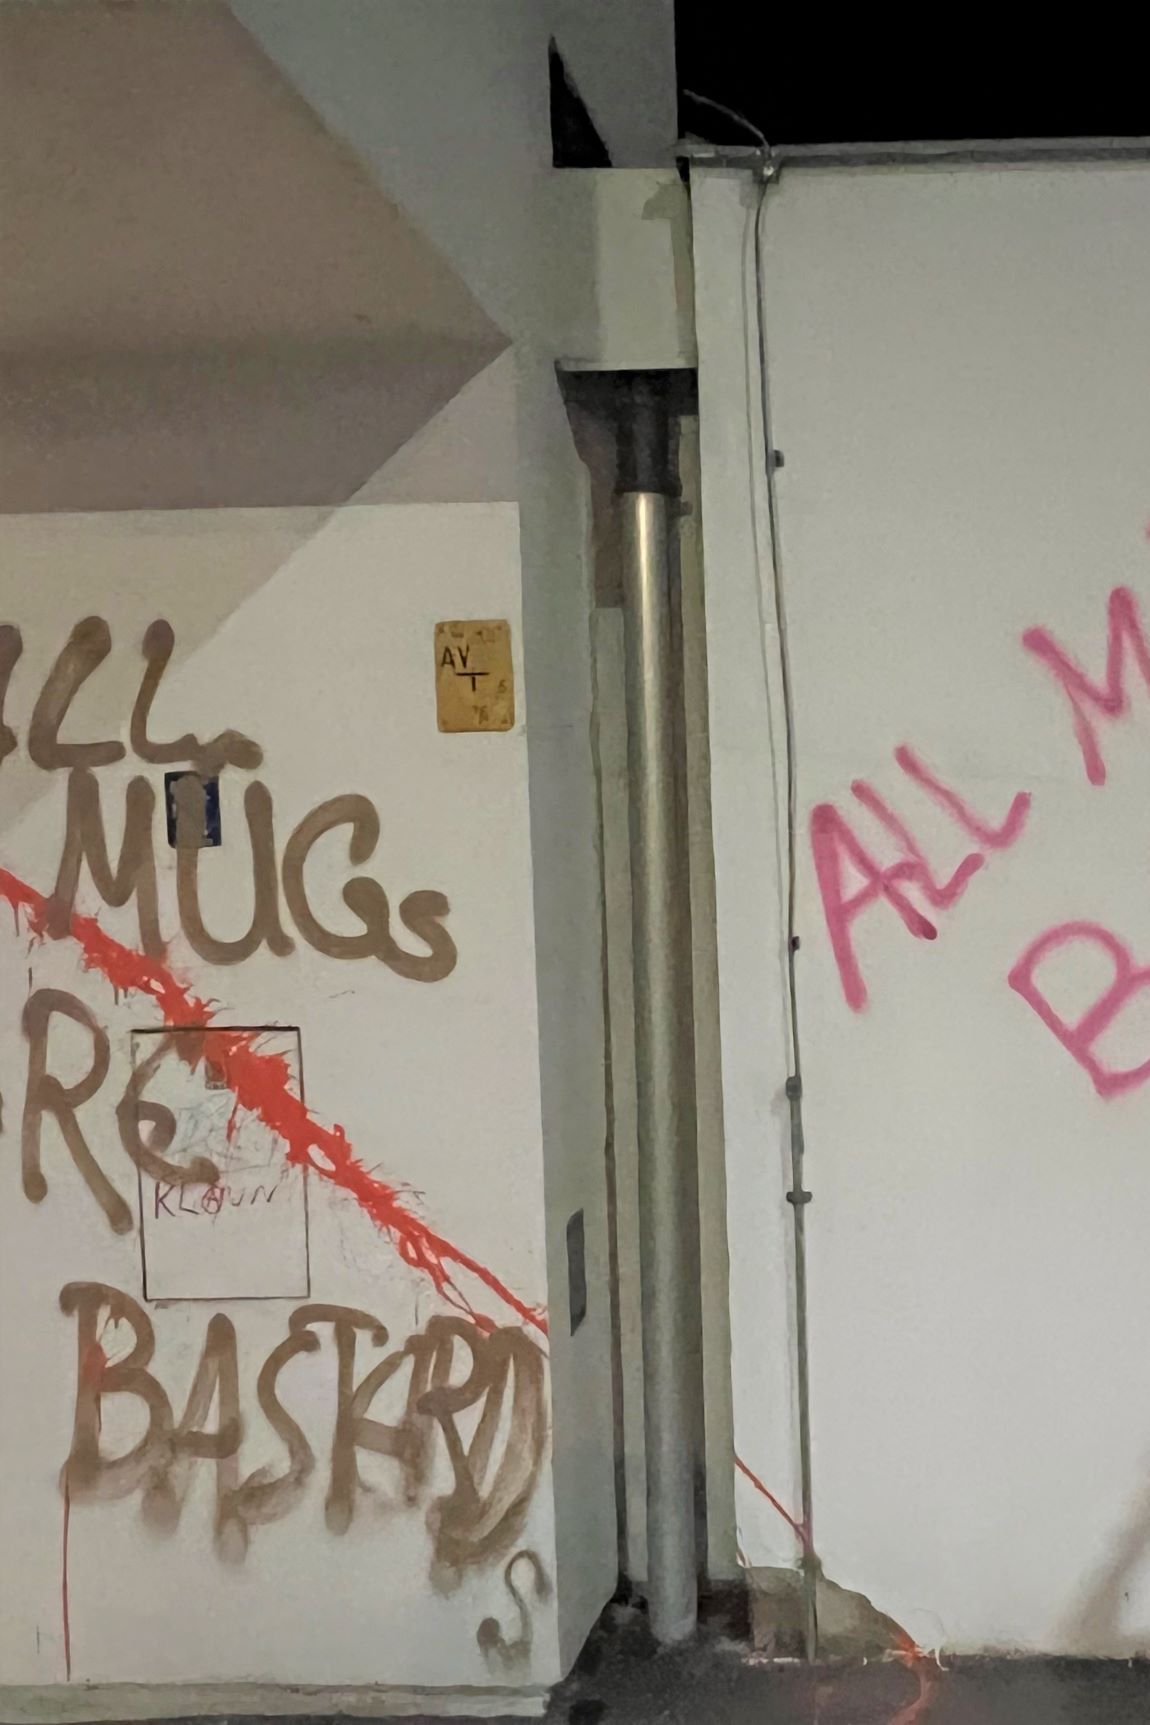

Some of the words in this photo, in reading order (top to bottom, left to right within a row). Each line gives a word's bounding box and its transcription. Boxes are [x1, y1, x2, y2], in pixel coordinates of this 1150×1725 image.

[0, 616, 204, 770] LL
[441, 644, 469, 671] AV
[810, 745, 1031, 1013] ALL
